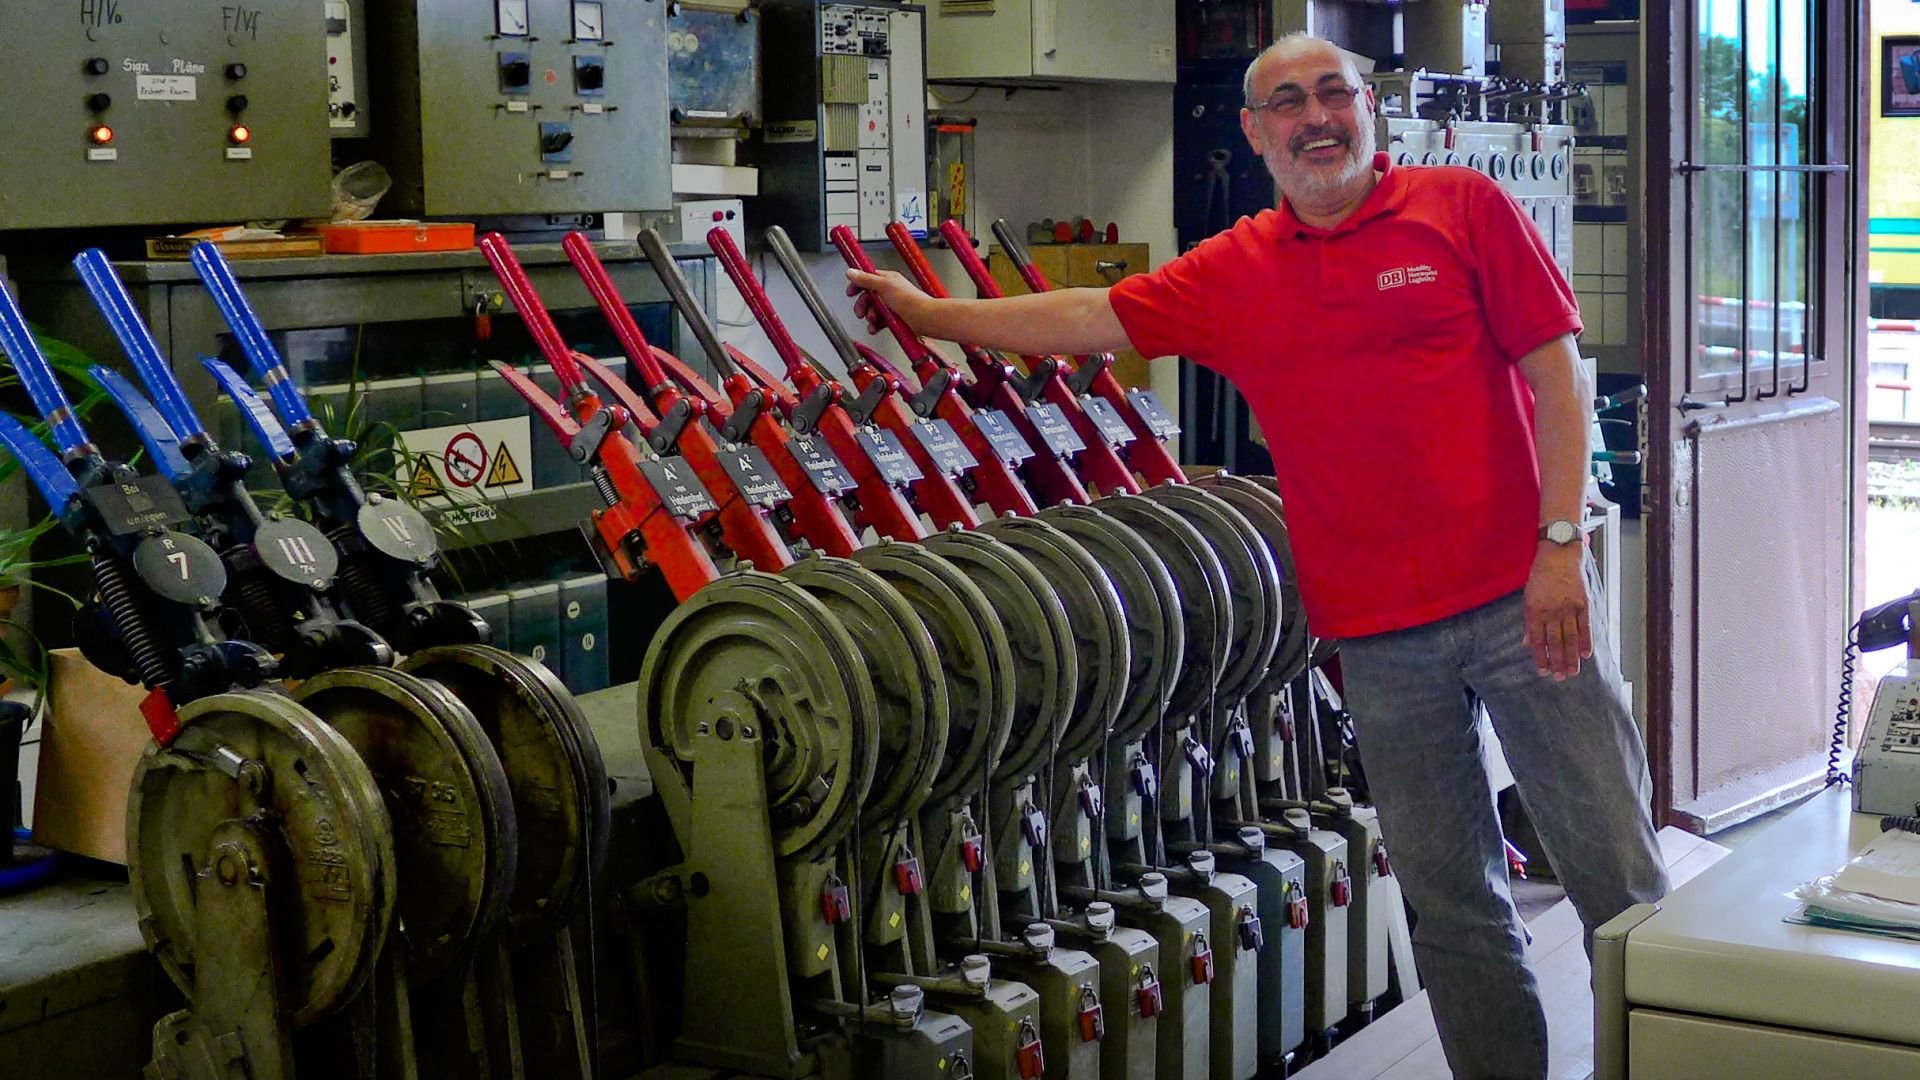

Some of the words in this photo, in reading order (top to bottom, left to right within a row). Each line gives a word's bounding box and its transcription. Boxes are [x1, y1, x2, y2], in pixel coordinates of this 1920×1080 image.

[1379, 269, 1404, 288] DB
[162, 538, 176, 550] R
[277, 536, 316, 566] III
[166, 551, 190, 580] 7
